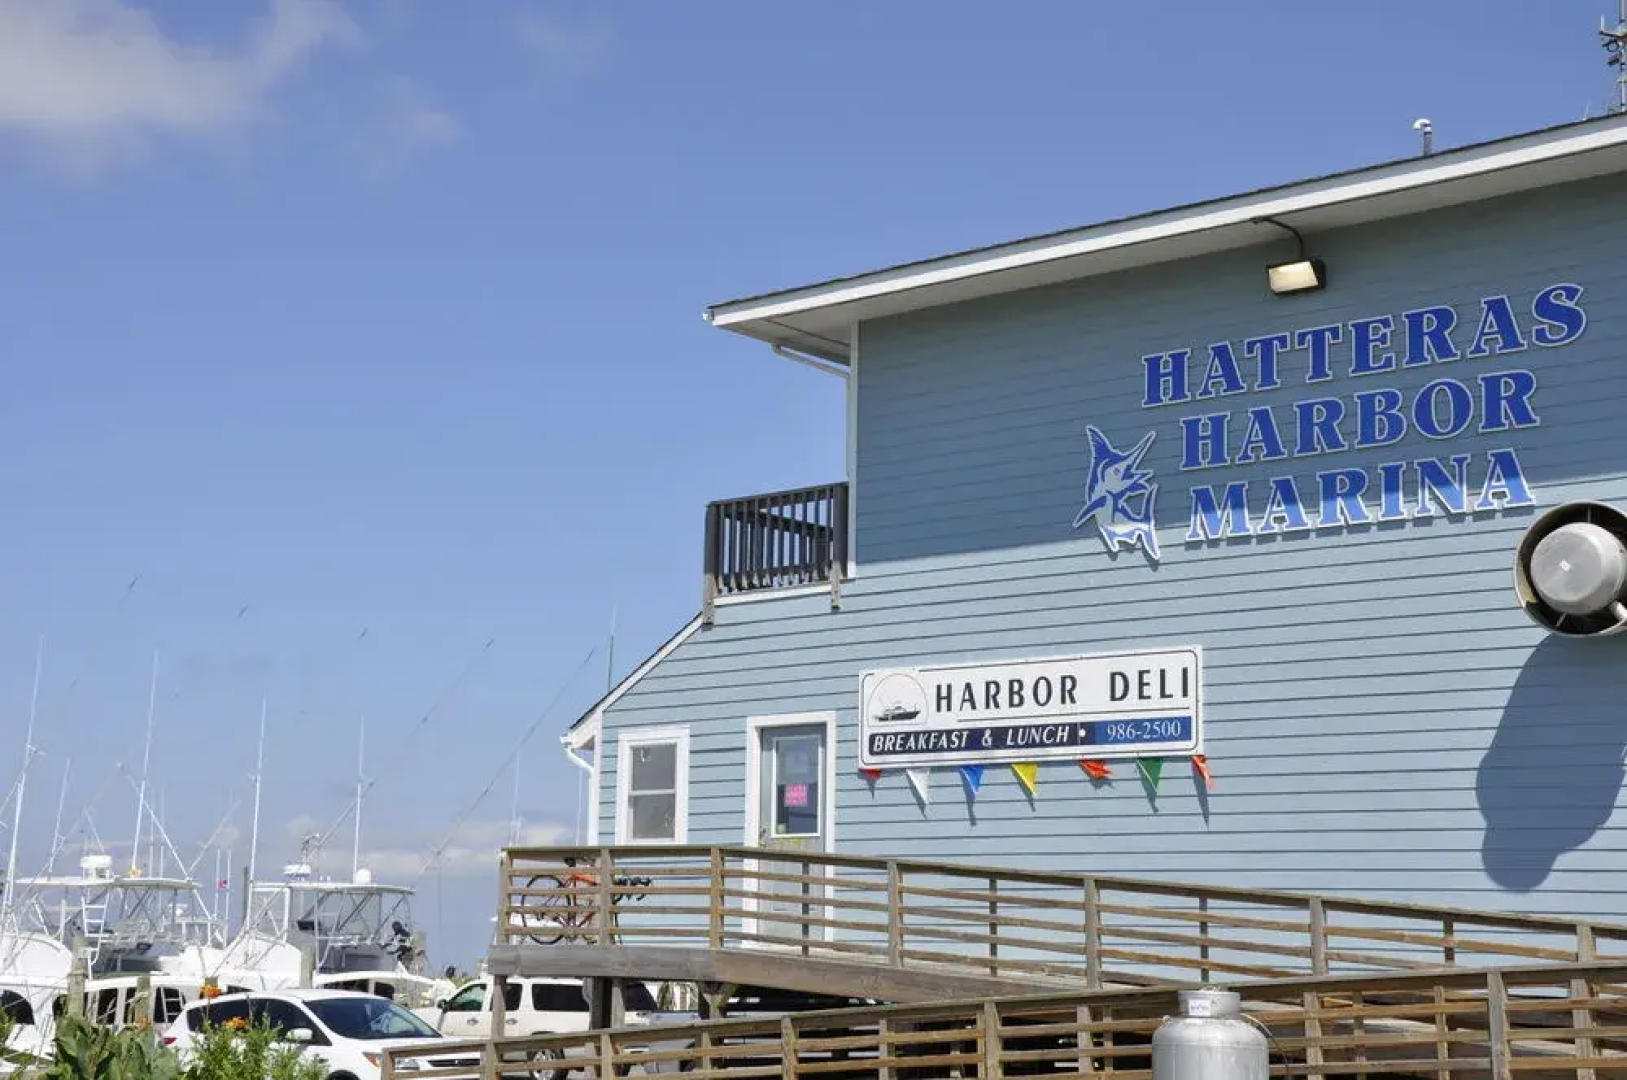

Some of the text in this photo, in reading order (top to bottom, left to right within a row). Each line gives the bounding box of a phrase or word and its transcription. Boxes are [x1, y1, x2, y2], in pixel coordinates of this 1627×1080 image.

[1142, 283, 1587, 407] HATTERAS
[1180, 369, 1540, 470] HARBOR
[1185, 448, 1536, 542] MARINA
[872, 717, 1181, 754] BREAKFAST & LUNCH 986-2500
[936, 667, 1189, 713] HARBOR DELI
